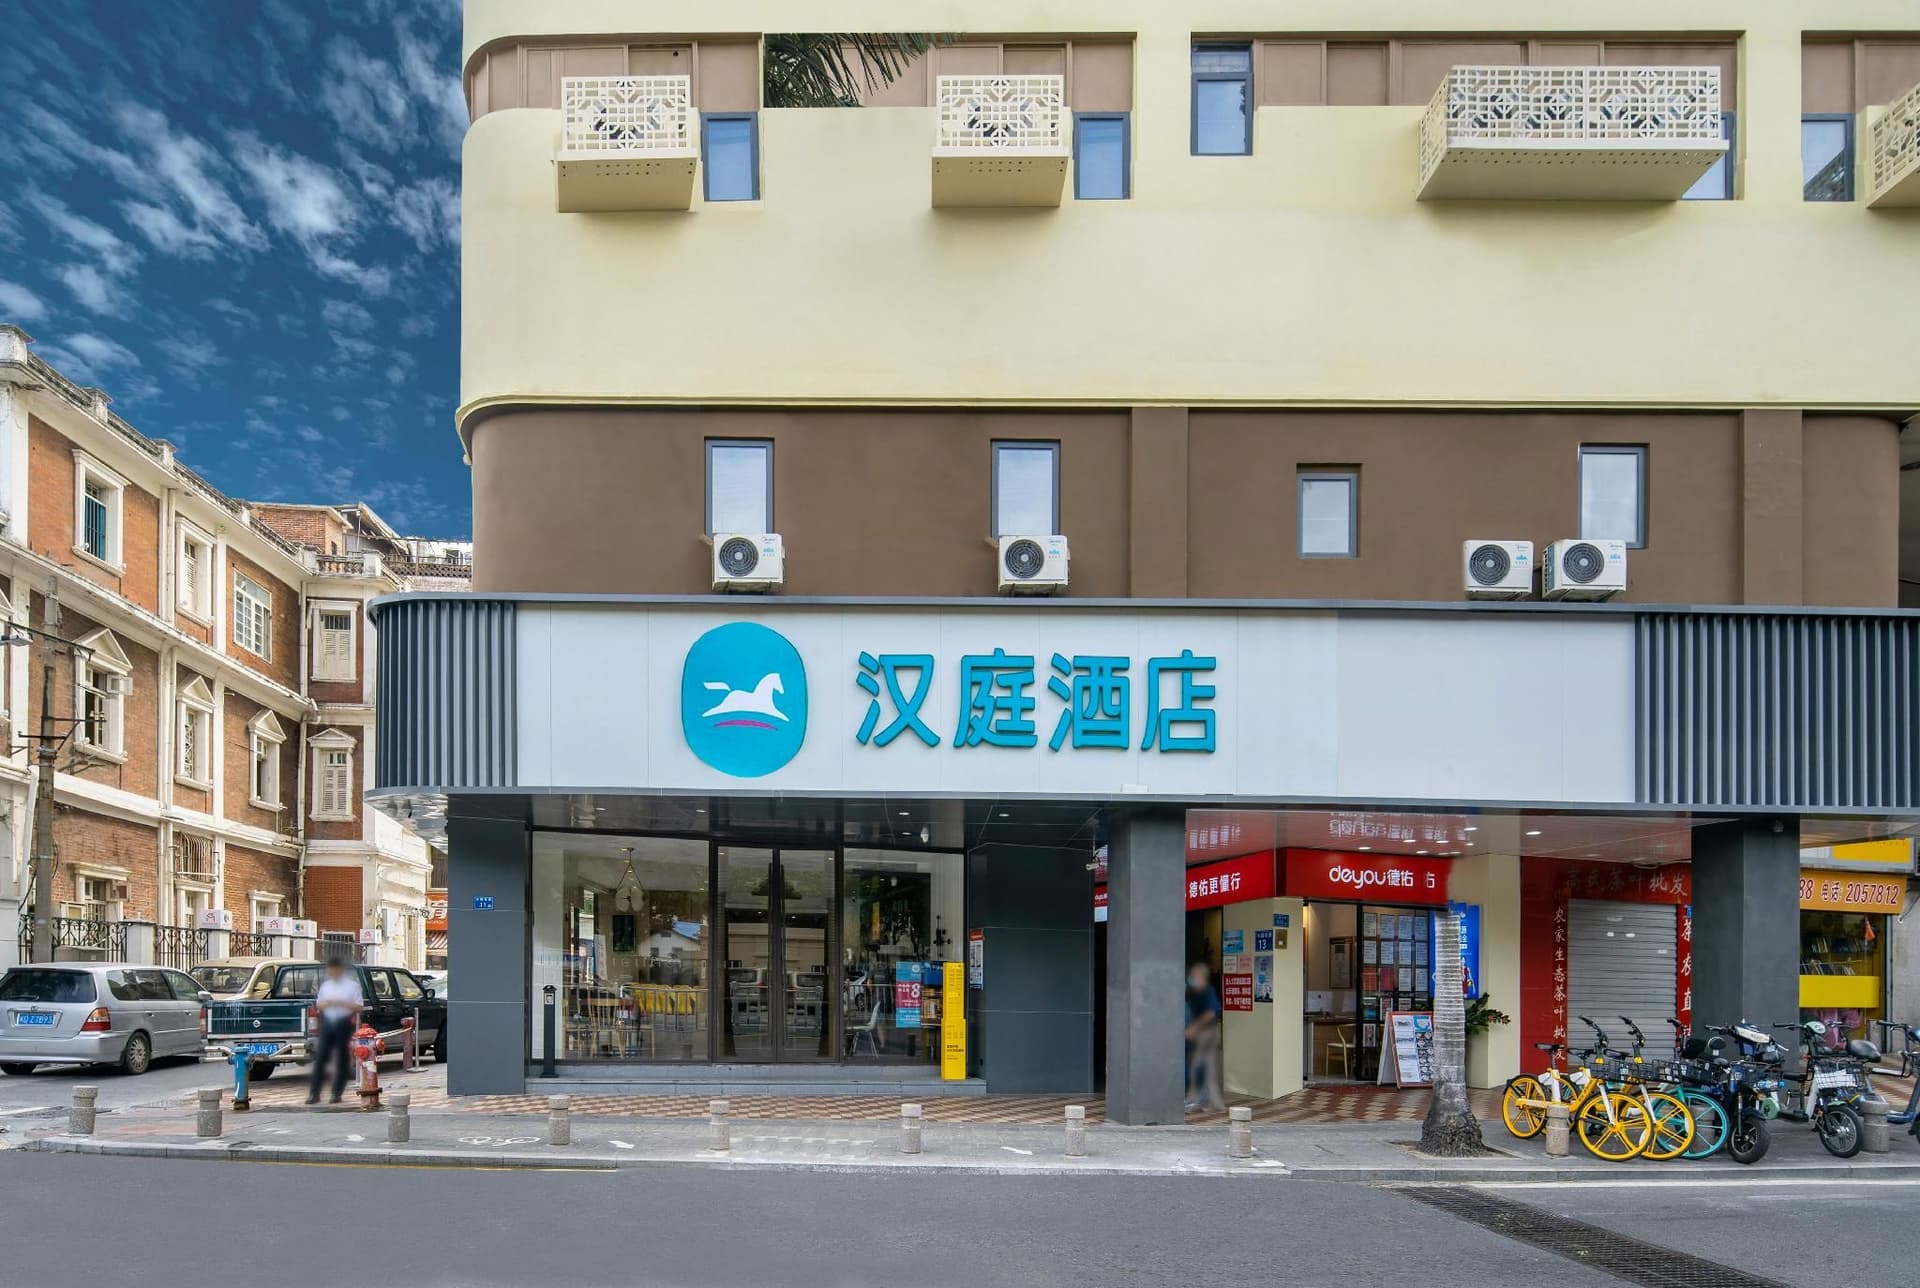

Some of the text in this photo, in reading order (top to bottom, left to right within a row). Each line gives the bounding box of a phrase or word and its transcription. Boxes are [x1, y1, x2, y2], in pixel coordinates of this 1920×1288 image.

[855, 647, 1217, 754] 汉庭酒店
[1188, 872, 1241, 899] 德佑更懂行
[1845, 882, 1901, 905] 2057812
